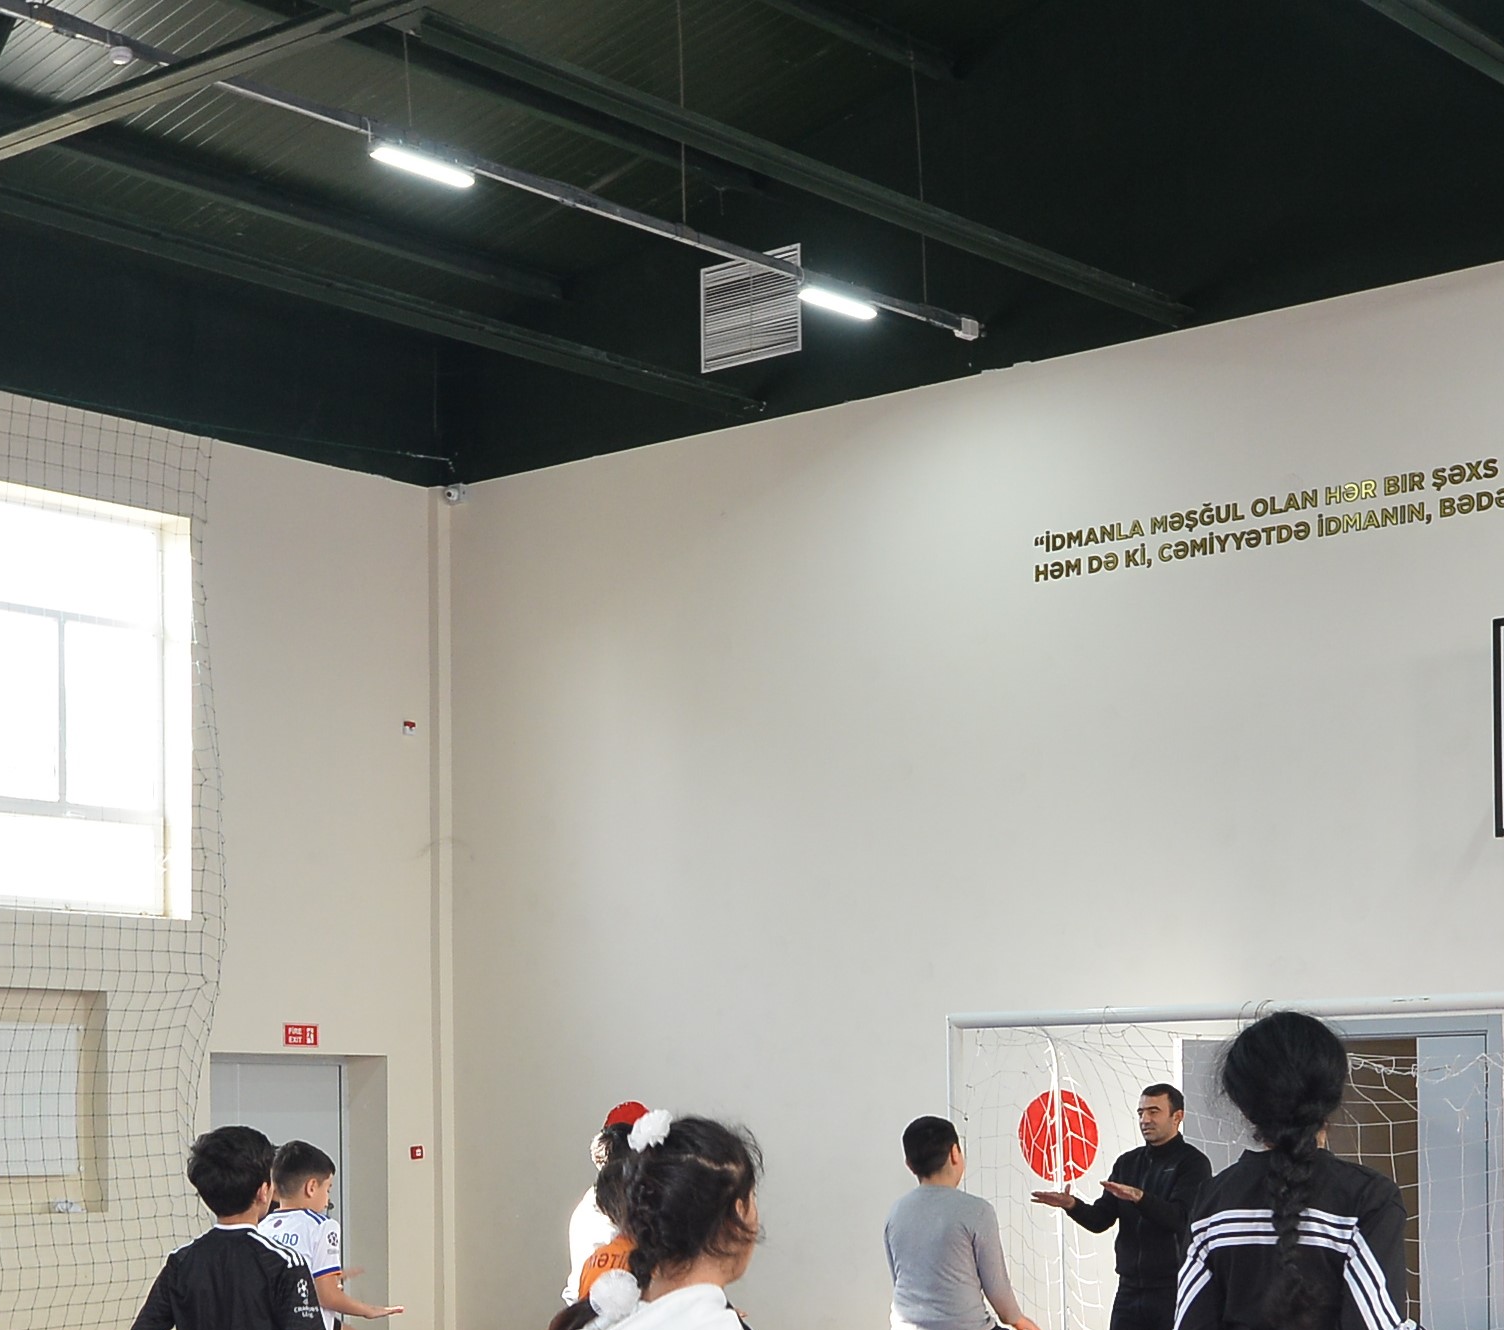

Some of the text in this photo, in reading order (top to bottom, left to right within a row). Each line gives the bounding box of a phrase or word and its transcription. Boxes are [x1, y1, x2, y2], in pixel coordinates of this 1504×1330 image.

[1150, 502, 1245, 535] MƏŞĞUL
[1251, 489, 1318, 517] OLAN
[1325, 479, 1376, 505] HƏR
[1432, 458, 1498, 491] ŞƏXS
[1034, 558, 1082, 583] HƏM
[1088, 552, 1119, 574] DƏ
[1124, 543, 1152, 568] Kİ,
[1158, 521, 1311, 562] CƏMİYYƏTDƏ
